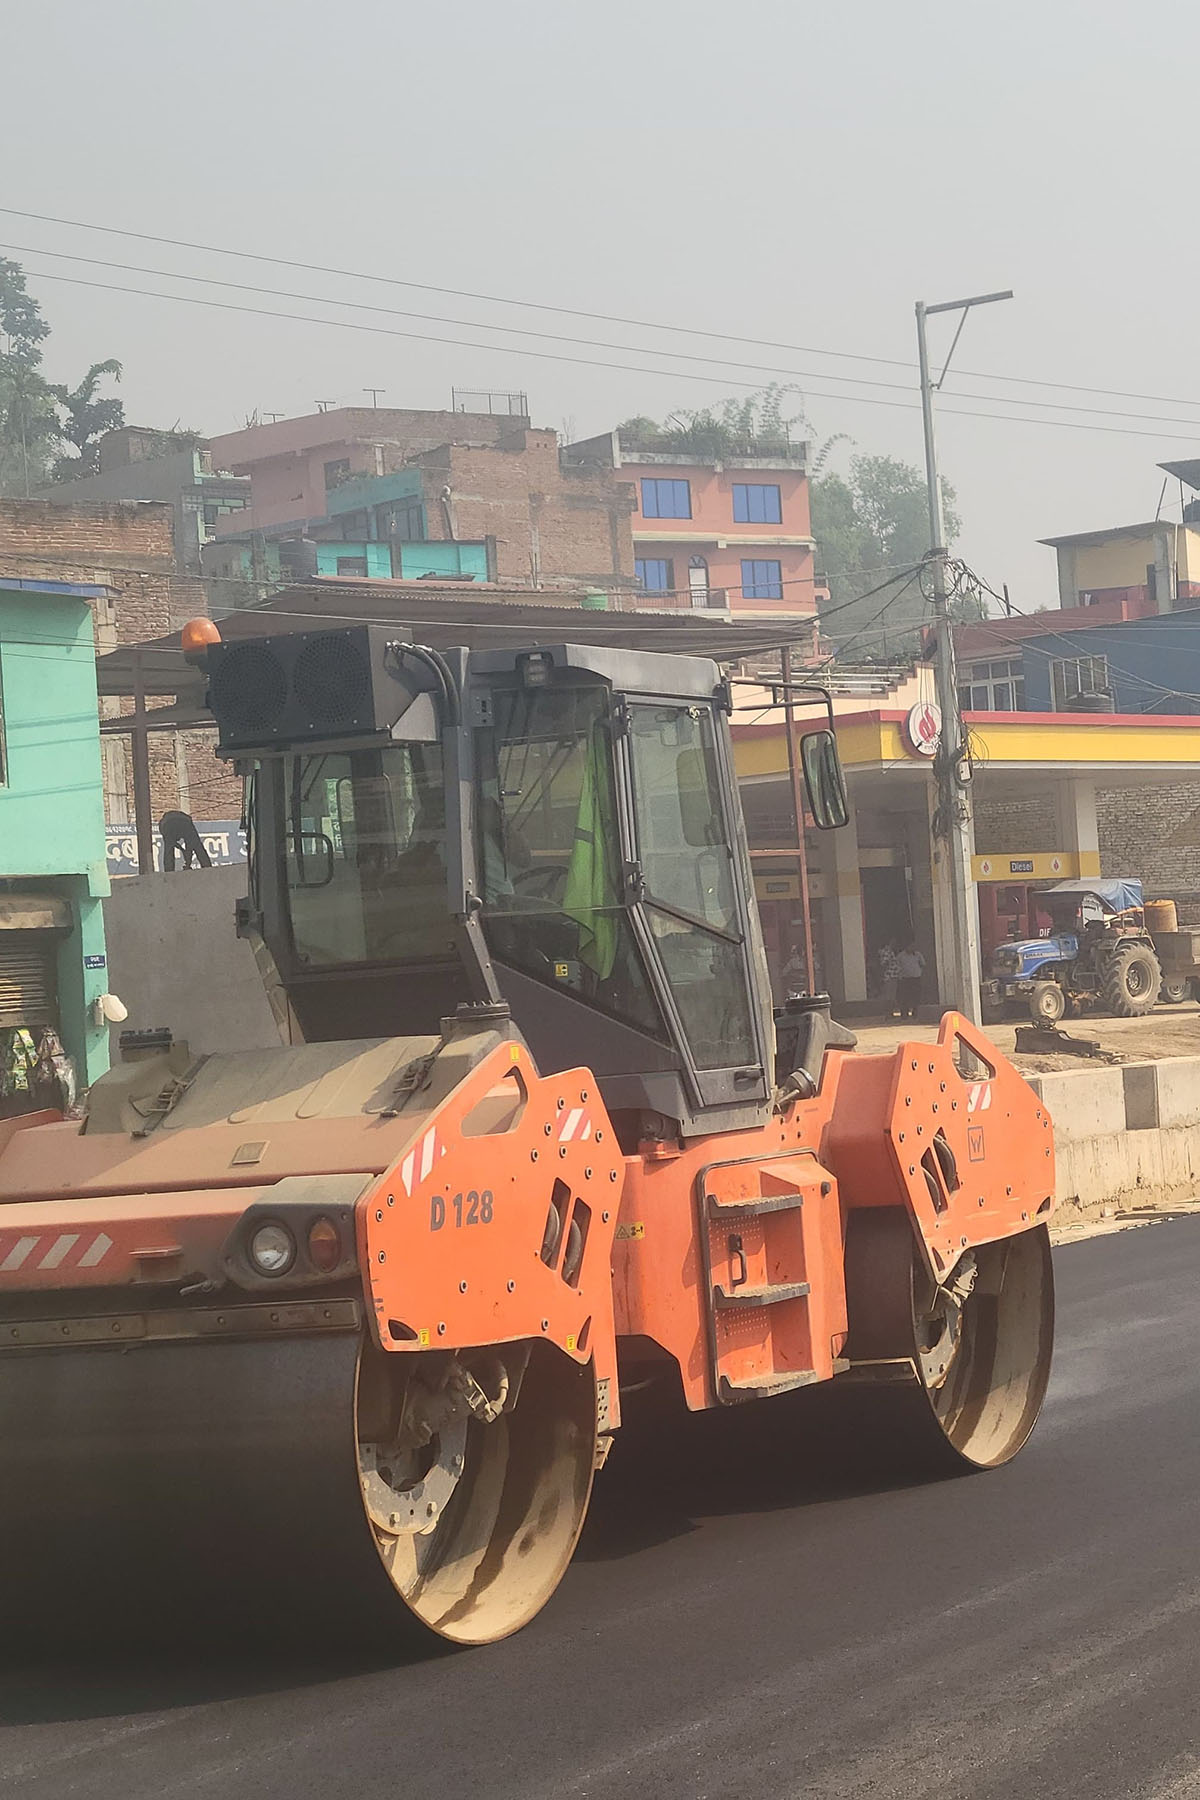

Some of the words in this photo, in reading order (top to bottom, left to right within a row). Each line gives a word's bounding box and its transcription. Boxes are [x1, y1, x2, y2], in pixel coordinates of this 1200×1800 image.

[1011, 862, 1032, 872] Diesel
[431, 1195, 446, 1232] D
[453, 1190, 493, 1228] 128
